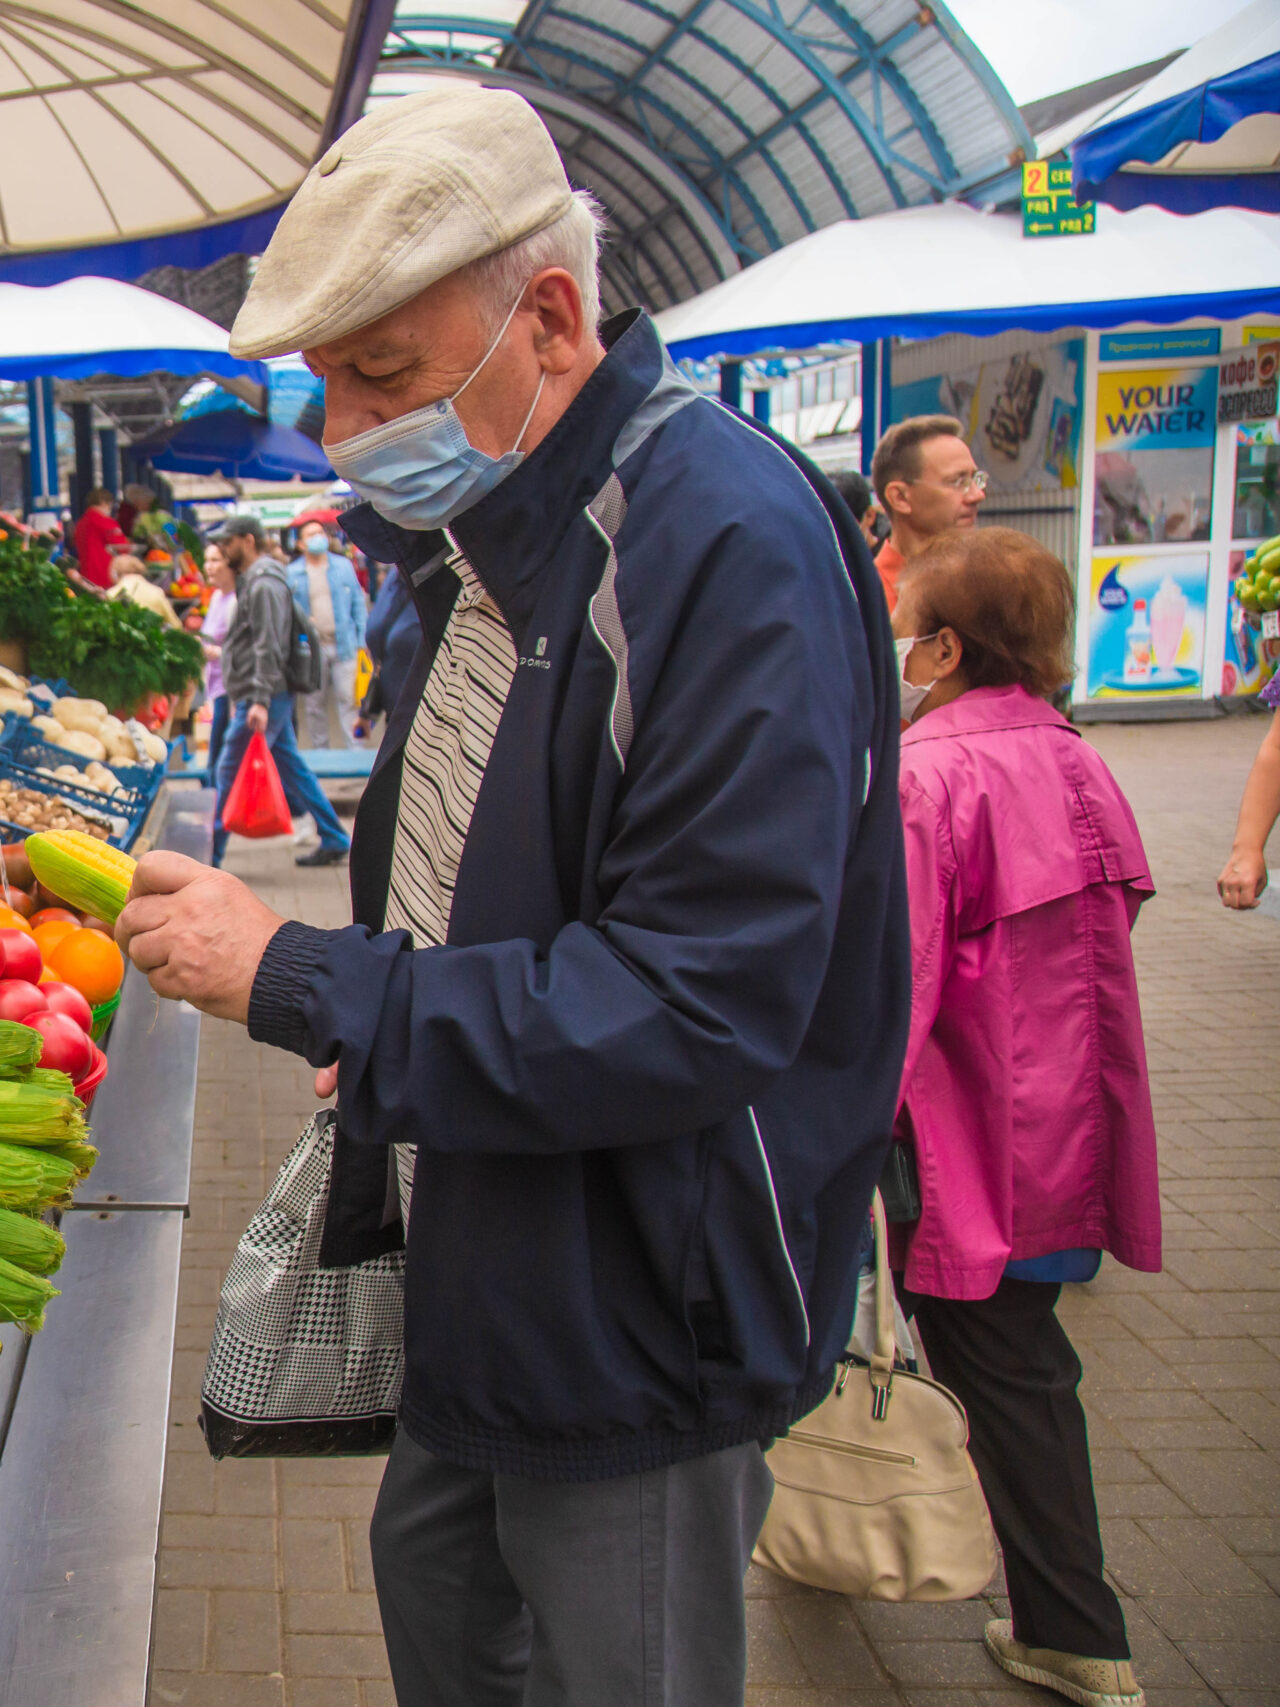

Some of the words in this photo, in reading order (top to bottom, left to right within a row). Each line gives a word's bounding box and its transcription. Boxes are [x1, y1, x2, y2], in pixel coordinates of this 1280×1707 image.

[1027, 168, 1041, 193] 2
[1220, 355, 1256, 388] кофе
[1118, 384, 1194, 409] YOUR
[1105, 410, 1205, 436] WATER
